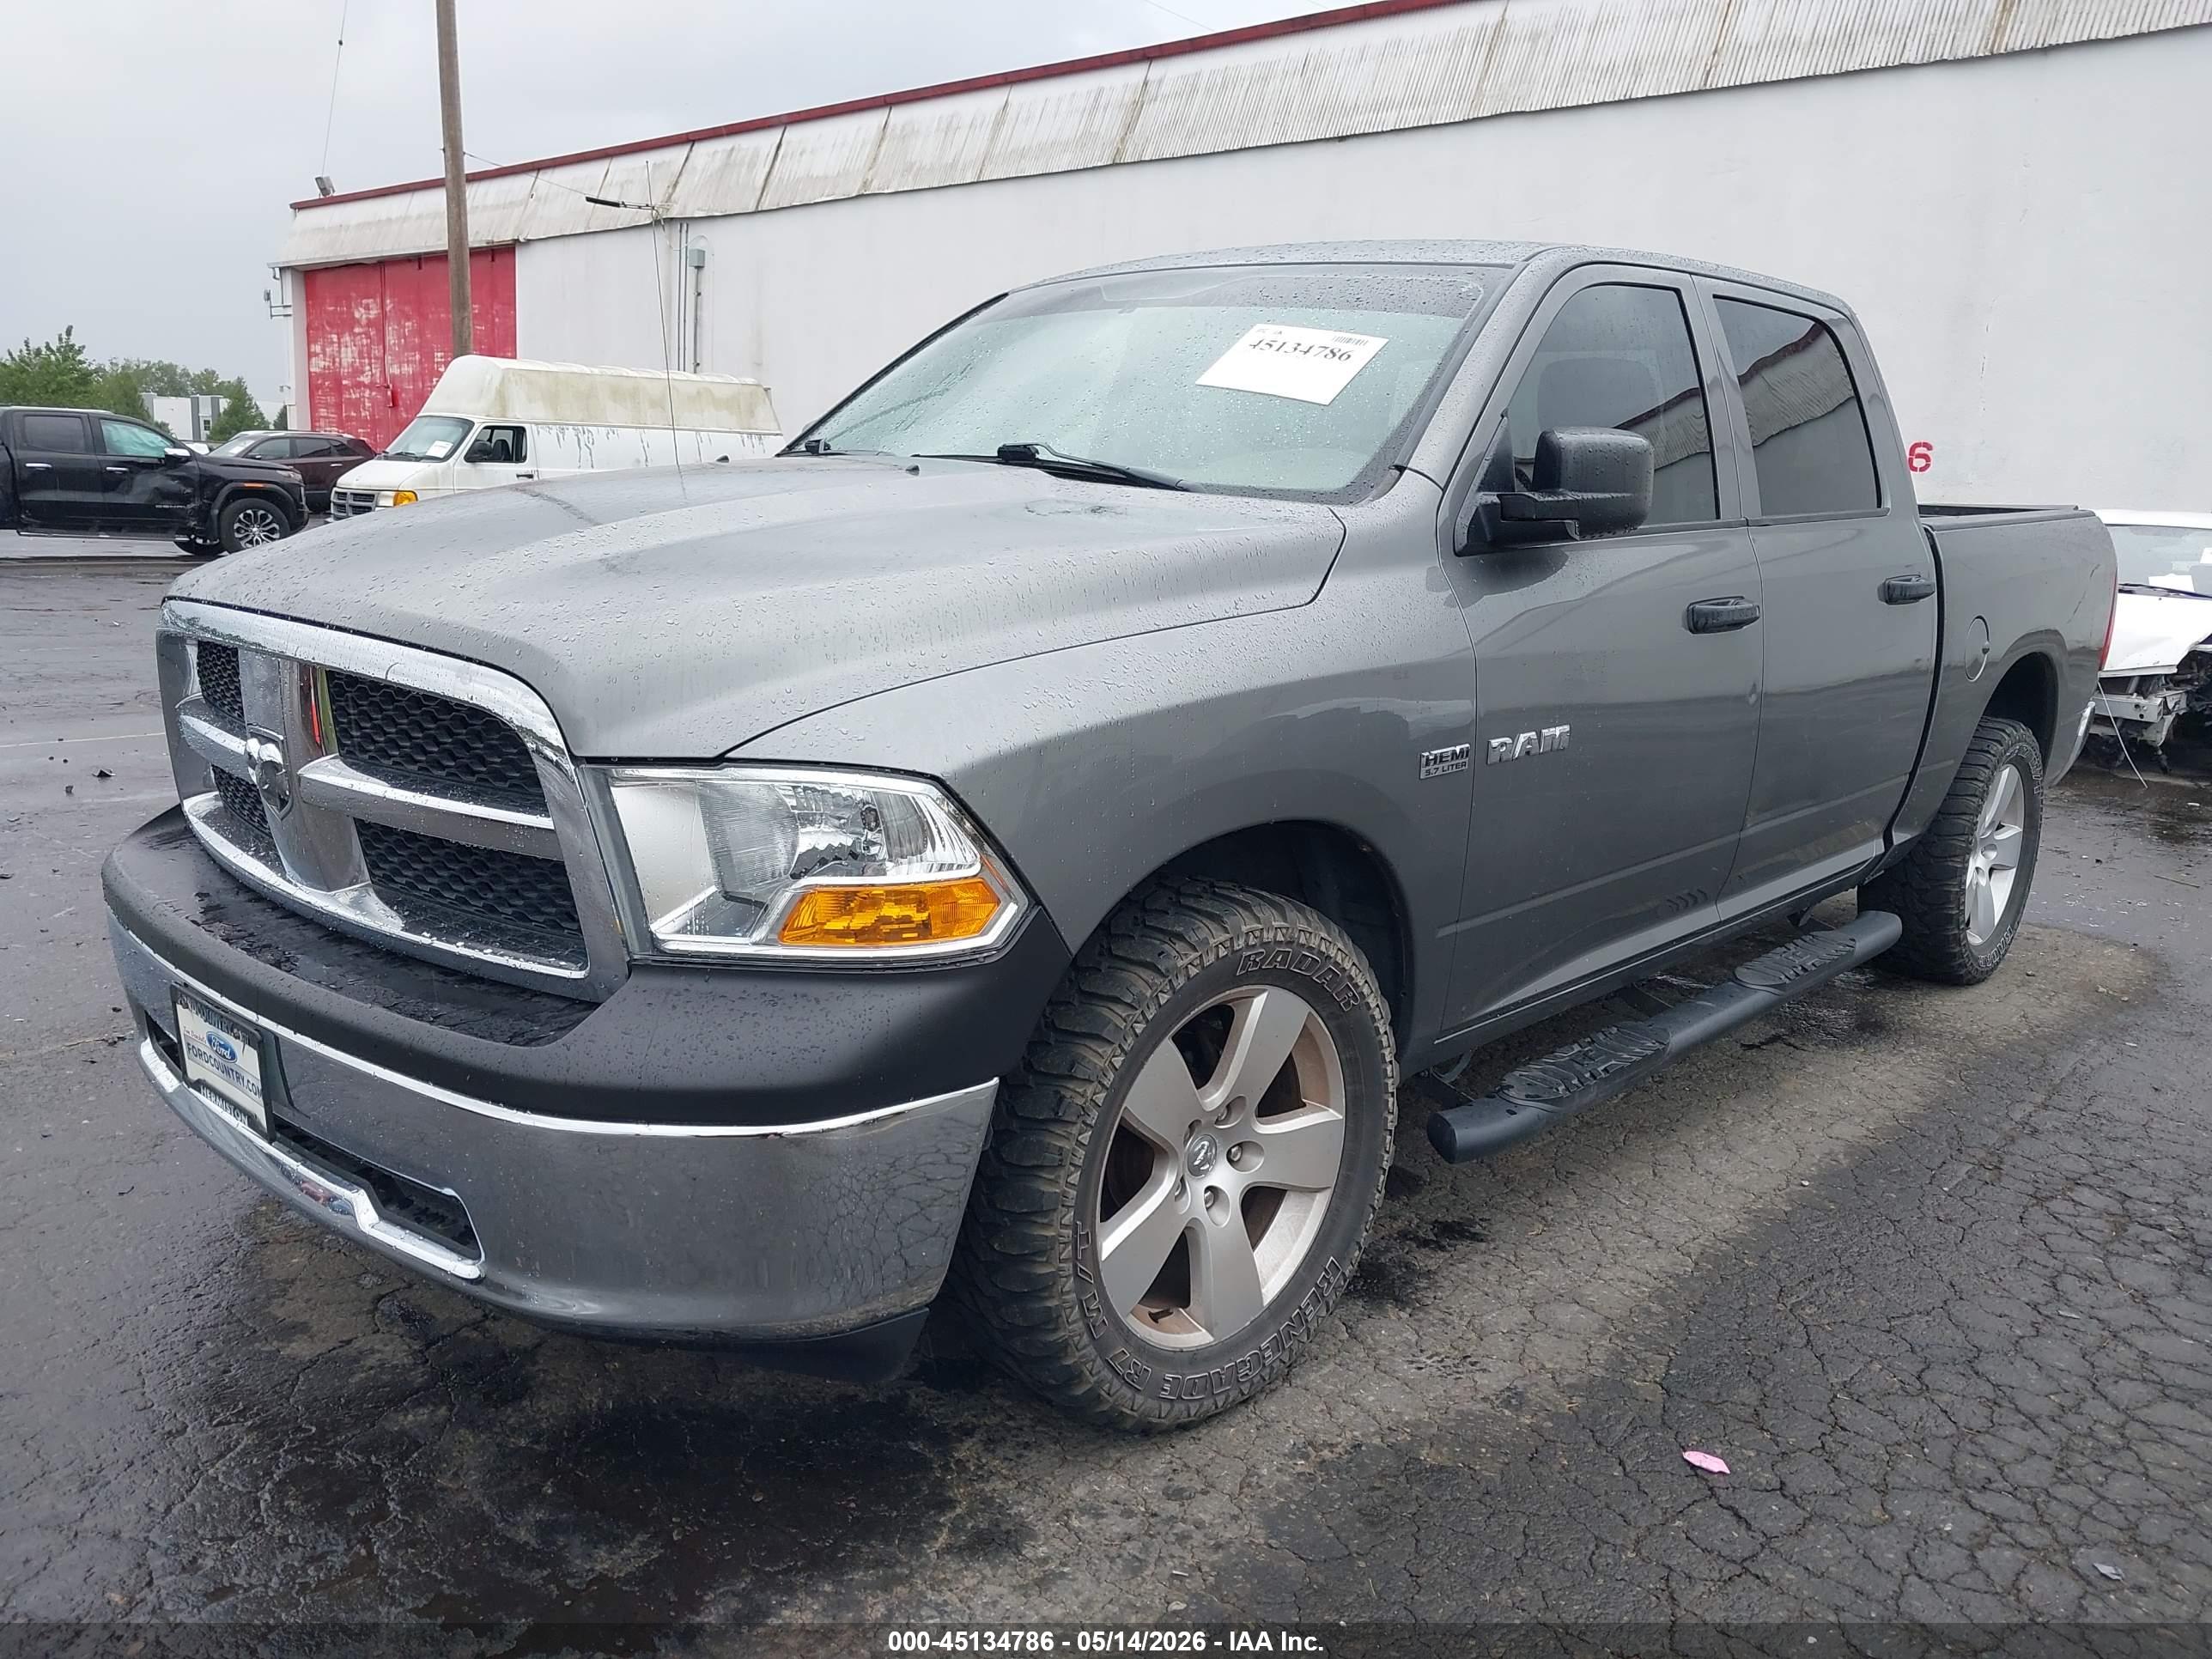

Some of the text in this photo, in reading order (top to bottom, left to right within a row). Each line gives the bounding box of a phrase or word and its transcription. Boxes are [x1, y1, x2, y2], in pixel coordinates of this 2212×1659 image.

[1249, 338, 1354, 362] 45134786
[1908, 441, 1934, 473] 6
[1422, 744, 1471, 769] HEMI
[1486, 725, 1571, 765] RAM
[1425, 761, 1467, 777] 5.7 LITER
[1237, 948, 1360, 1012] RADAR
[210, 1035, 233, 1060] Ford
[186, 1042, 263, 1099] FORDCOUNTRY.COM
[200, 1085, 248, 1127] HERMISTON
[1158, 1255, 1347, 1401] RENEGADE
[1106, 1346, 1152, 1391] R7
